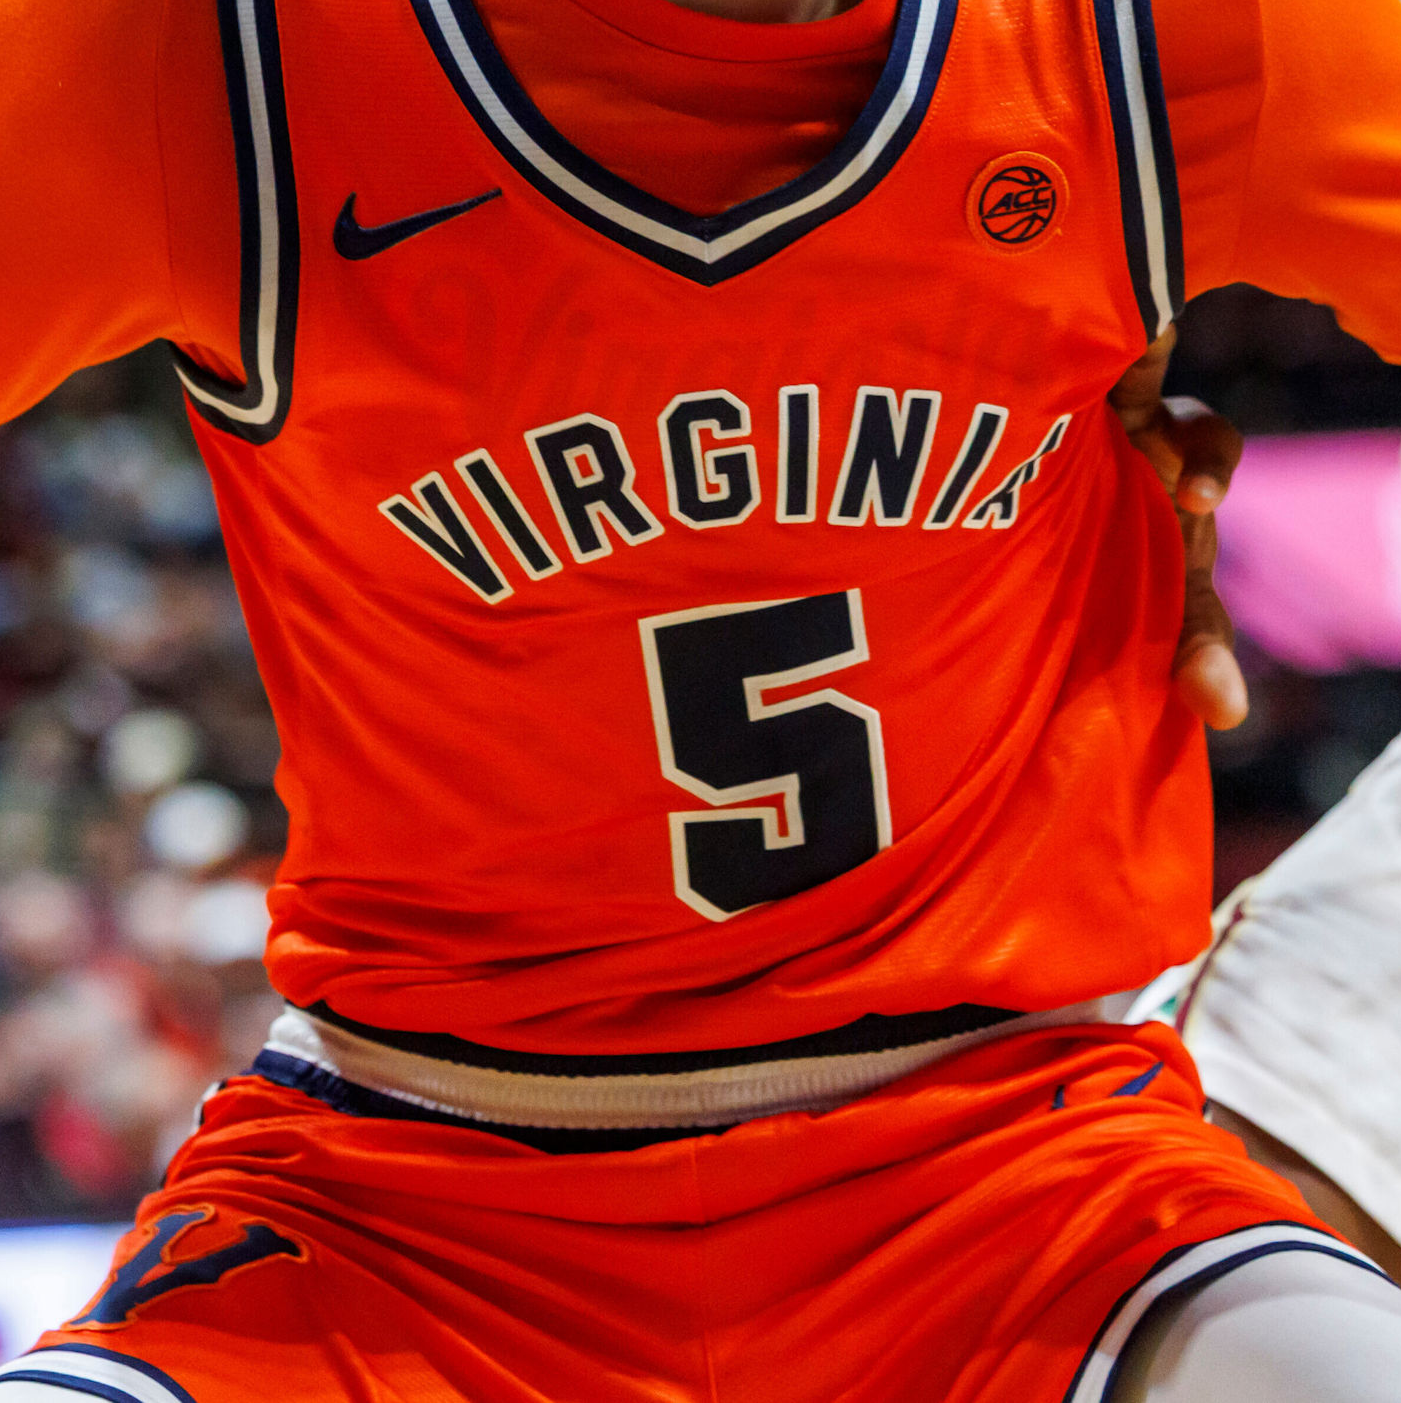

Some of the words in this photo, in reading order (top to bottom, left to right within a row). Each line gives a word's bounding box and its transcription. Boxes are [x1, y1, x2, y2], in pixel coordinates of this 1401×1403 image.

[982, 185, 1053, 218] ACC
[378, 384, 1072, 604] VIRGINIA
[638, 588, 893, 923] 5
